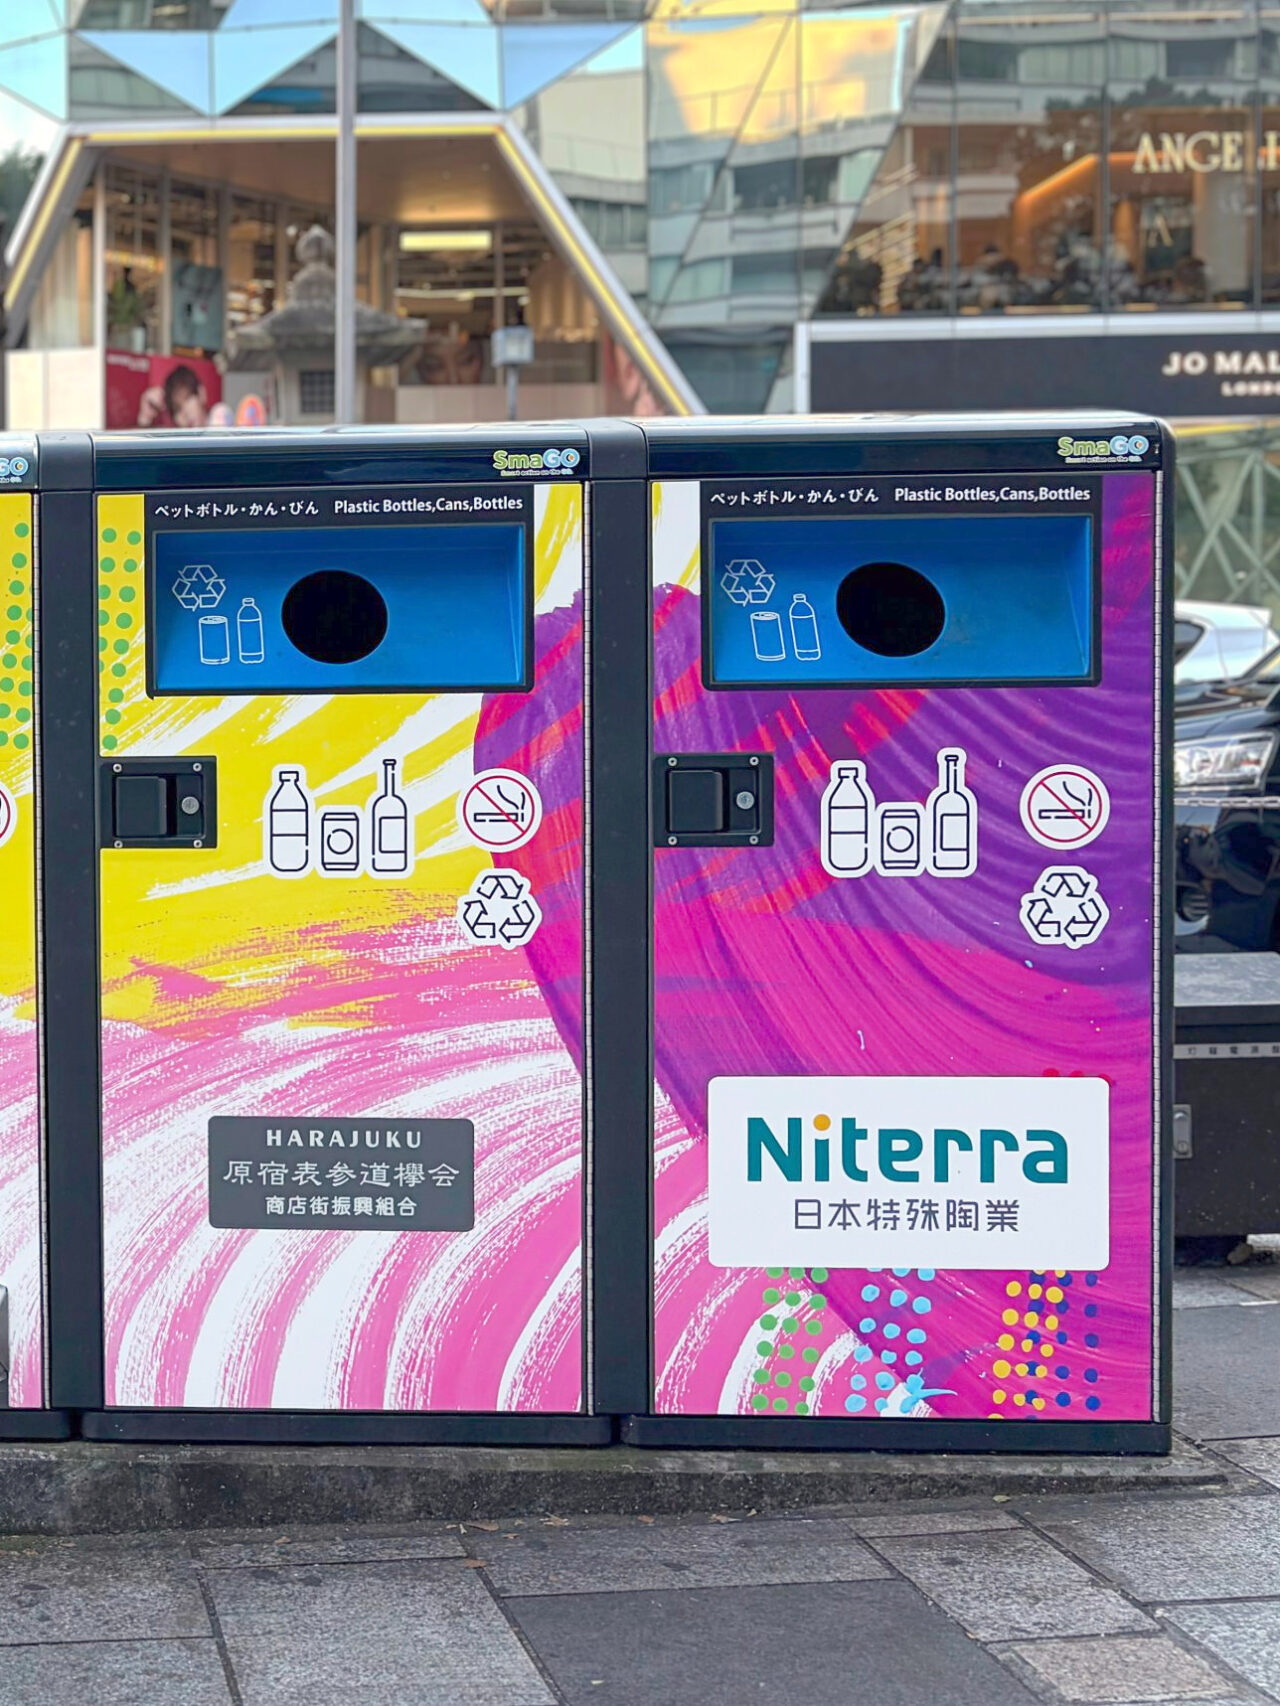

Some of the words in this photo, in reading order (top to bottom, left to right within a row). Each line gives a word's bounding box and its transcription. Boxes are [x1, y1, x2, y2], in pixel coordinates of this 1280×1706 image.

[1131, 130, 1280, 174] ANGEI
[1162, 351, 1208, 376] JO
[1057, 435, 1149, 456] SmaGO
[493, 448, 580, 469] SmaGO
[895, 488, 941, 501] Plastic
[334, 499, 380, 513] Plastic
[266, 1129, 421, 1149] HARAJUKU
[747, 1113, 1068, 1183] Niterra
[264, 1196, 417, 1216] 商店街振興組合
[794, 1198, 1020, 1232] 日本特殊陶業
